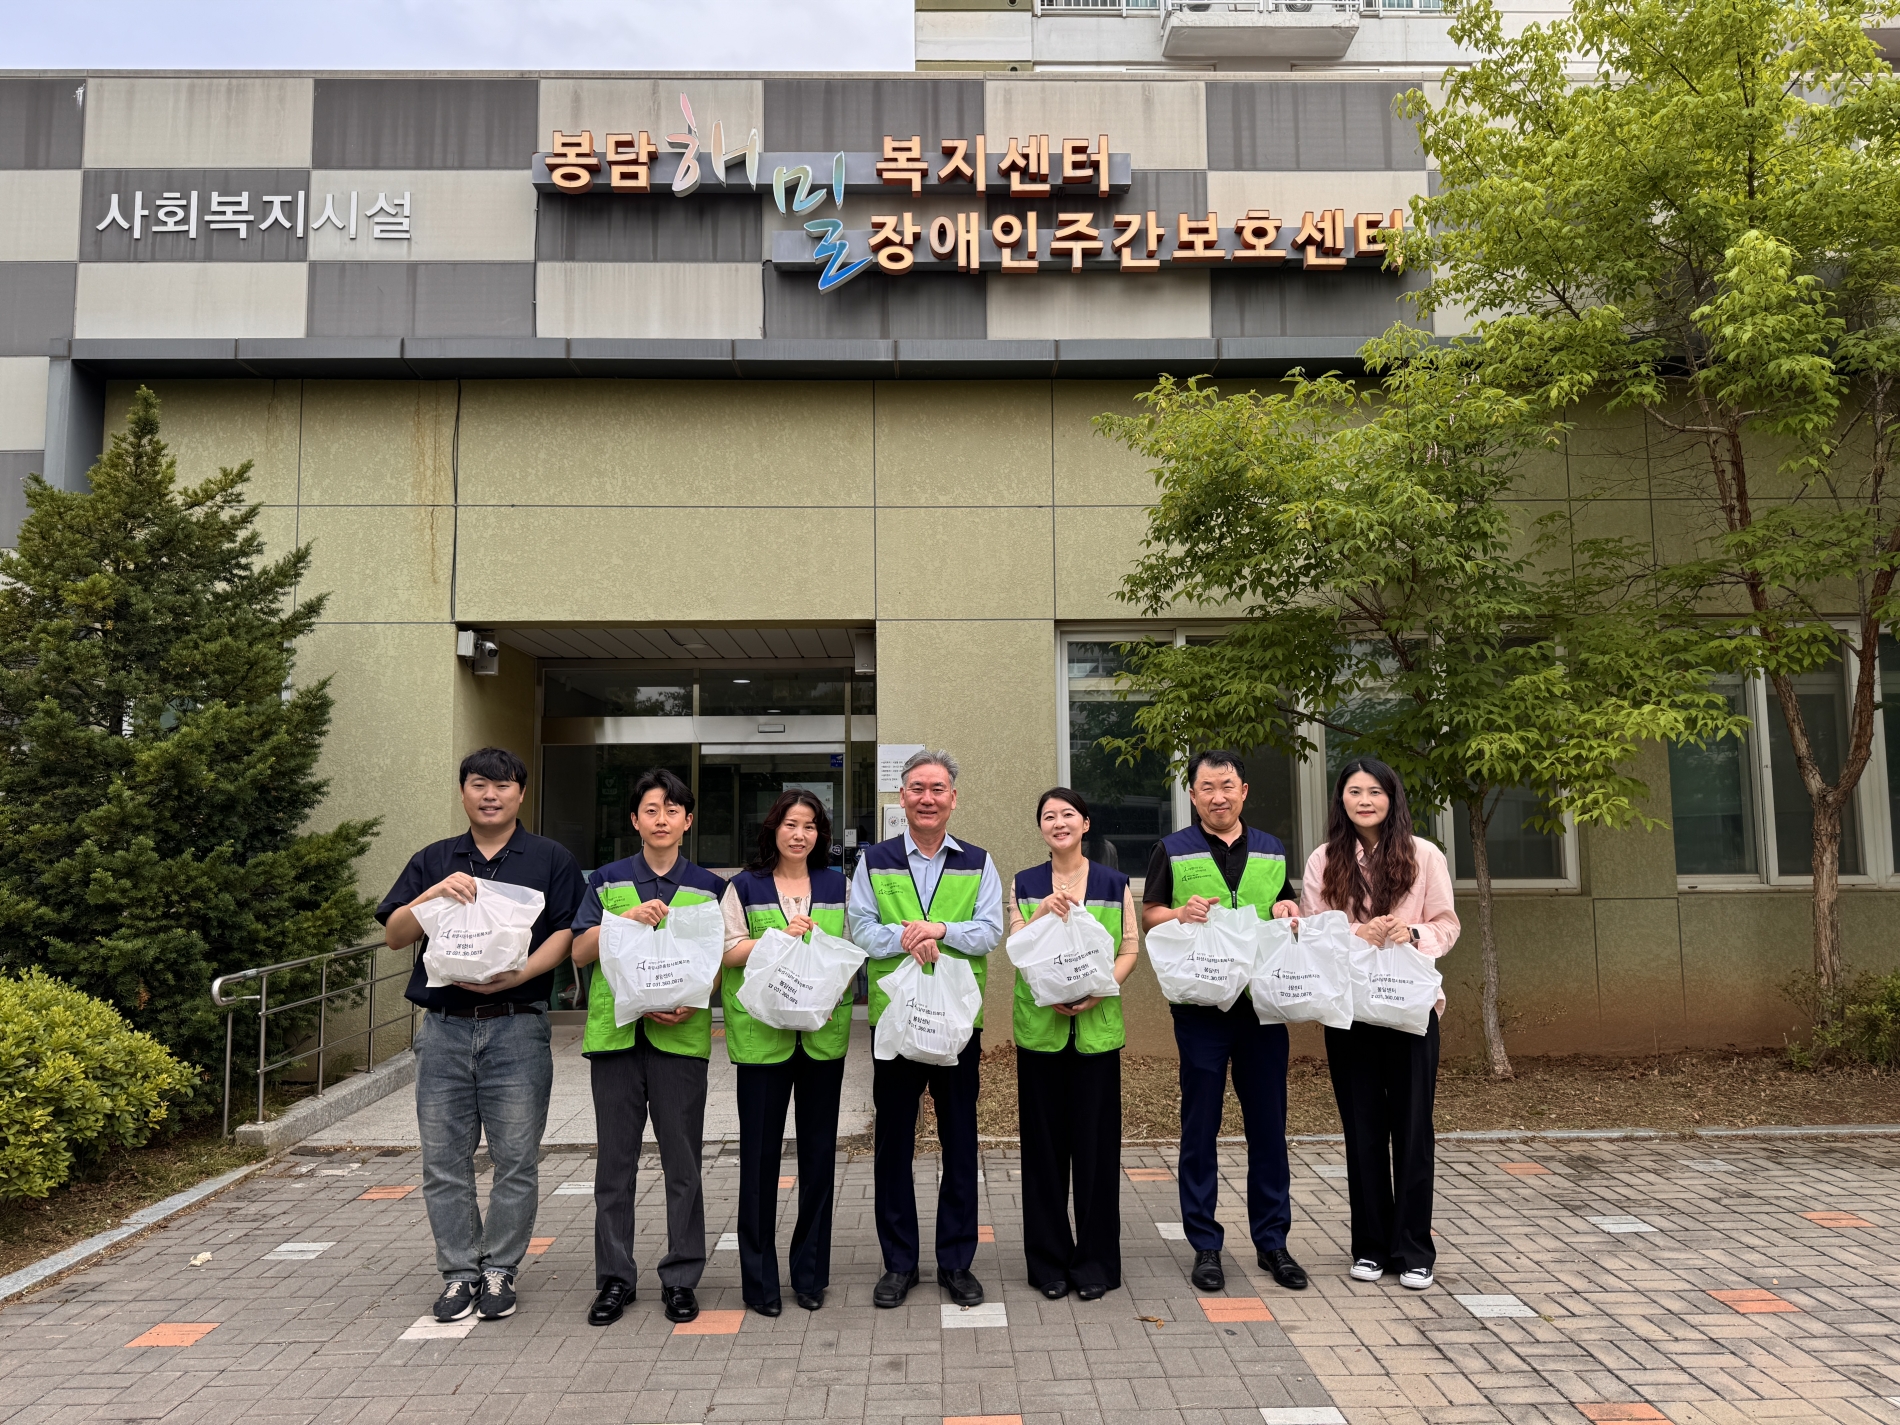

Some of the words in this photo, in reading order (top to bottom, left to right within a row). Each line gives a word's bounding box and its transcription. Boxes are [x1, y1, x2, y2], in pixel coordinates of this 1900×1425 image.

[545, 130, 660, 195] 봉담
[875, 134, 1111, 198] 복지센터
[96, 190, 413, 240] 사회복지시설
